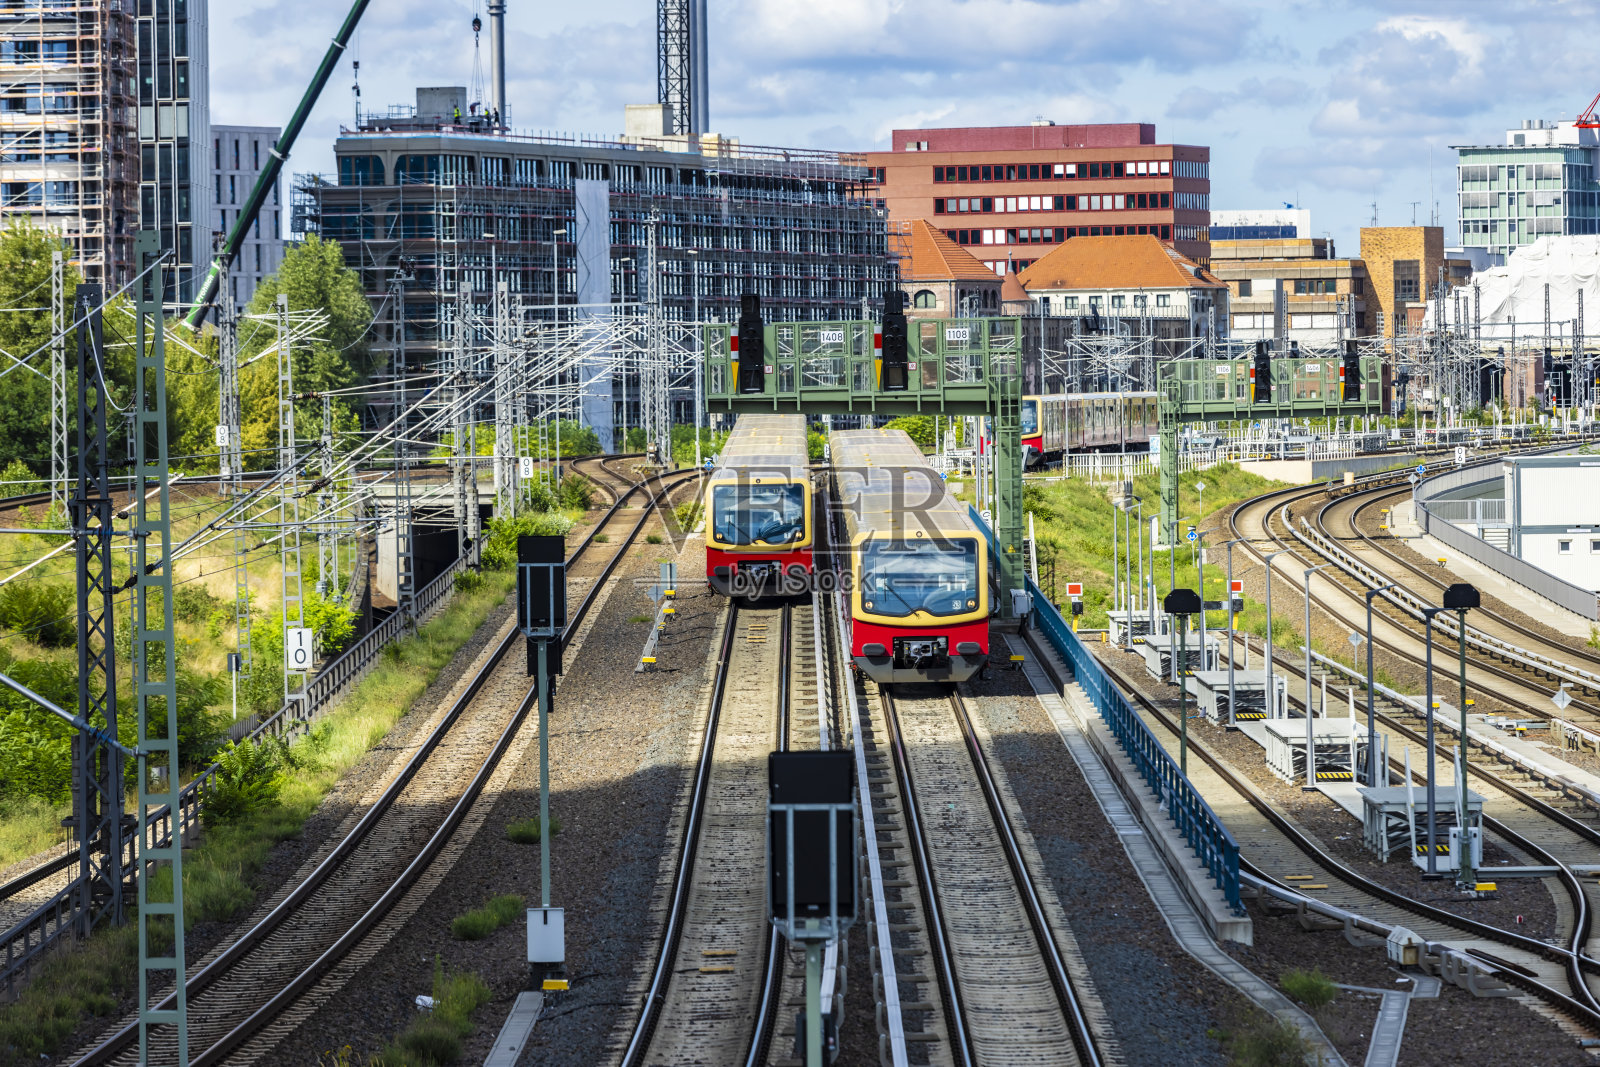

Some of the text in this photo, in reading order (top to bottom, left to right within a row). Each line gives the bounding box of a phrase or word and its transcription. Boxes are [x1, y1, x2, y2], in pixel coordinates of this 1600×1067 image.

[822, 331, 843, 342] 1408
[947, 329, 968, 339] 1108
[1217, 365, 1230, 373] 1106
[1306, 364, 1320, 372] 1406
